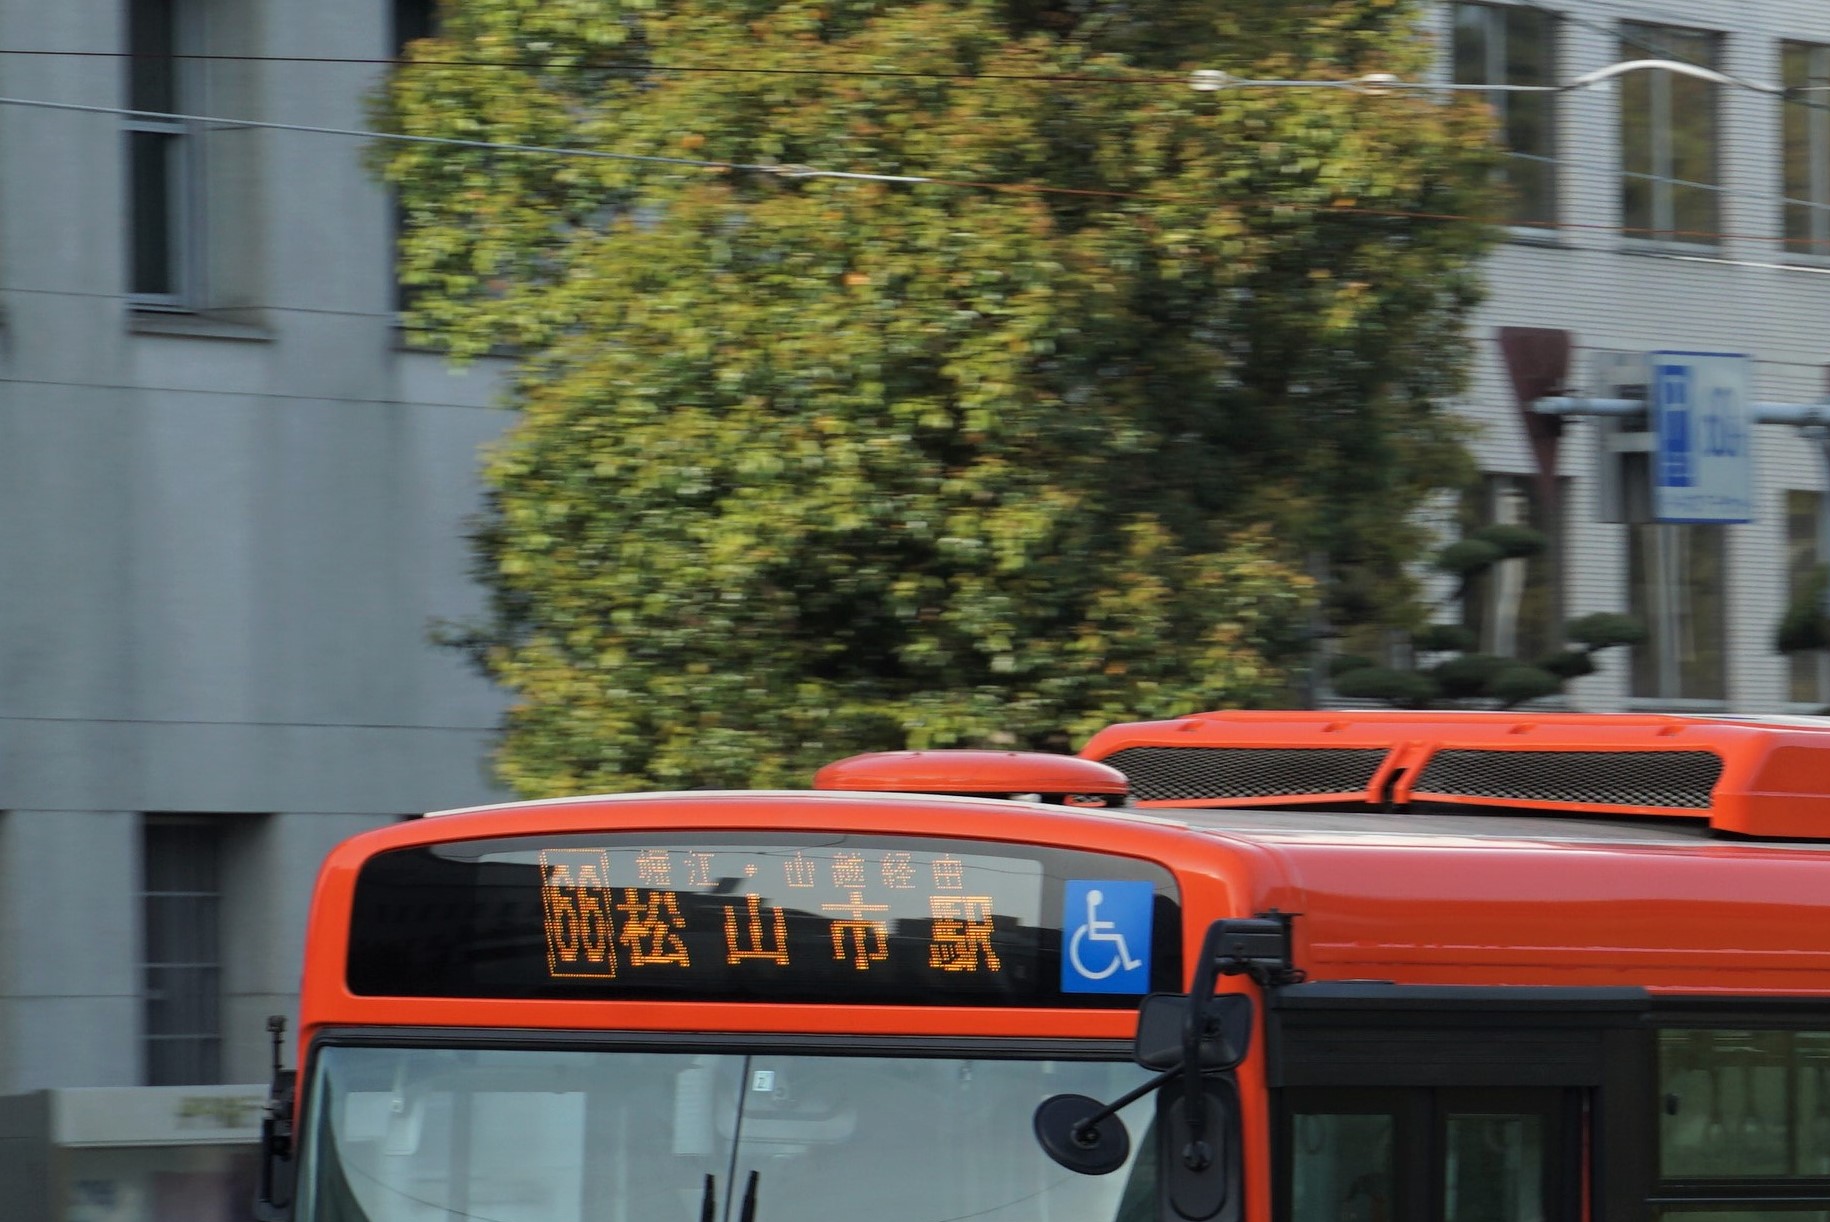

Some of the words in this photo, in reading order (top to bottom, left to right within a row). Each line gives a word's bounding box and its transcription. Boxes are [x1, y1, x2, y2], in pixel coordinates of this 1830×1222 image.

[550, 863, 607, 962] 66
[615, 886, 1001, 973] 松山市駅
